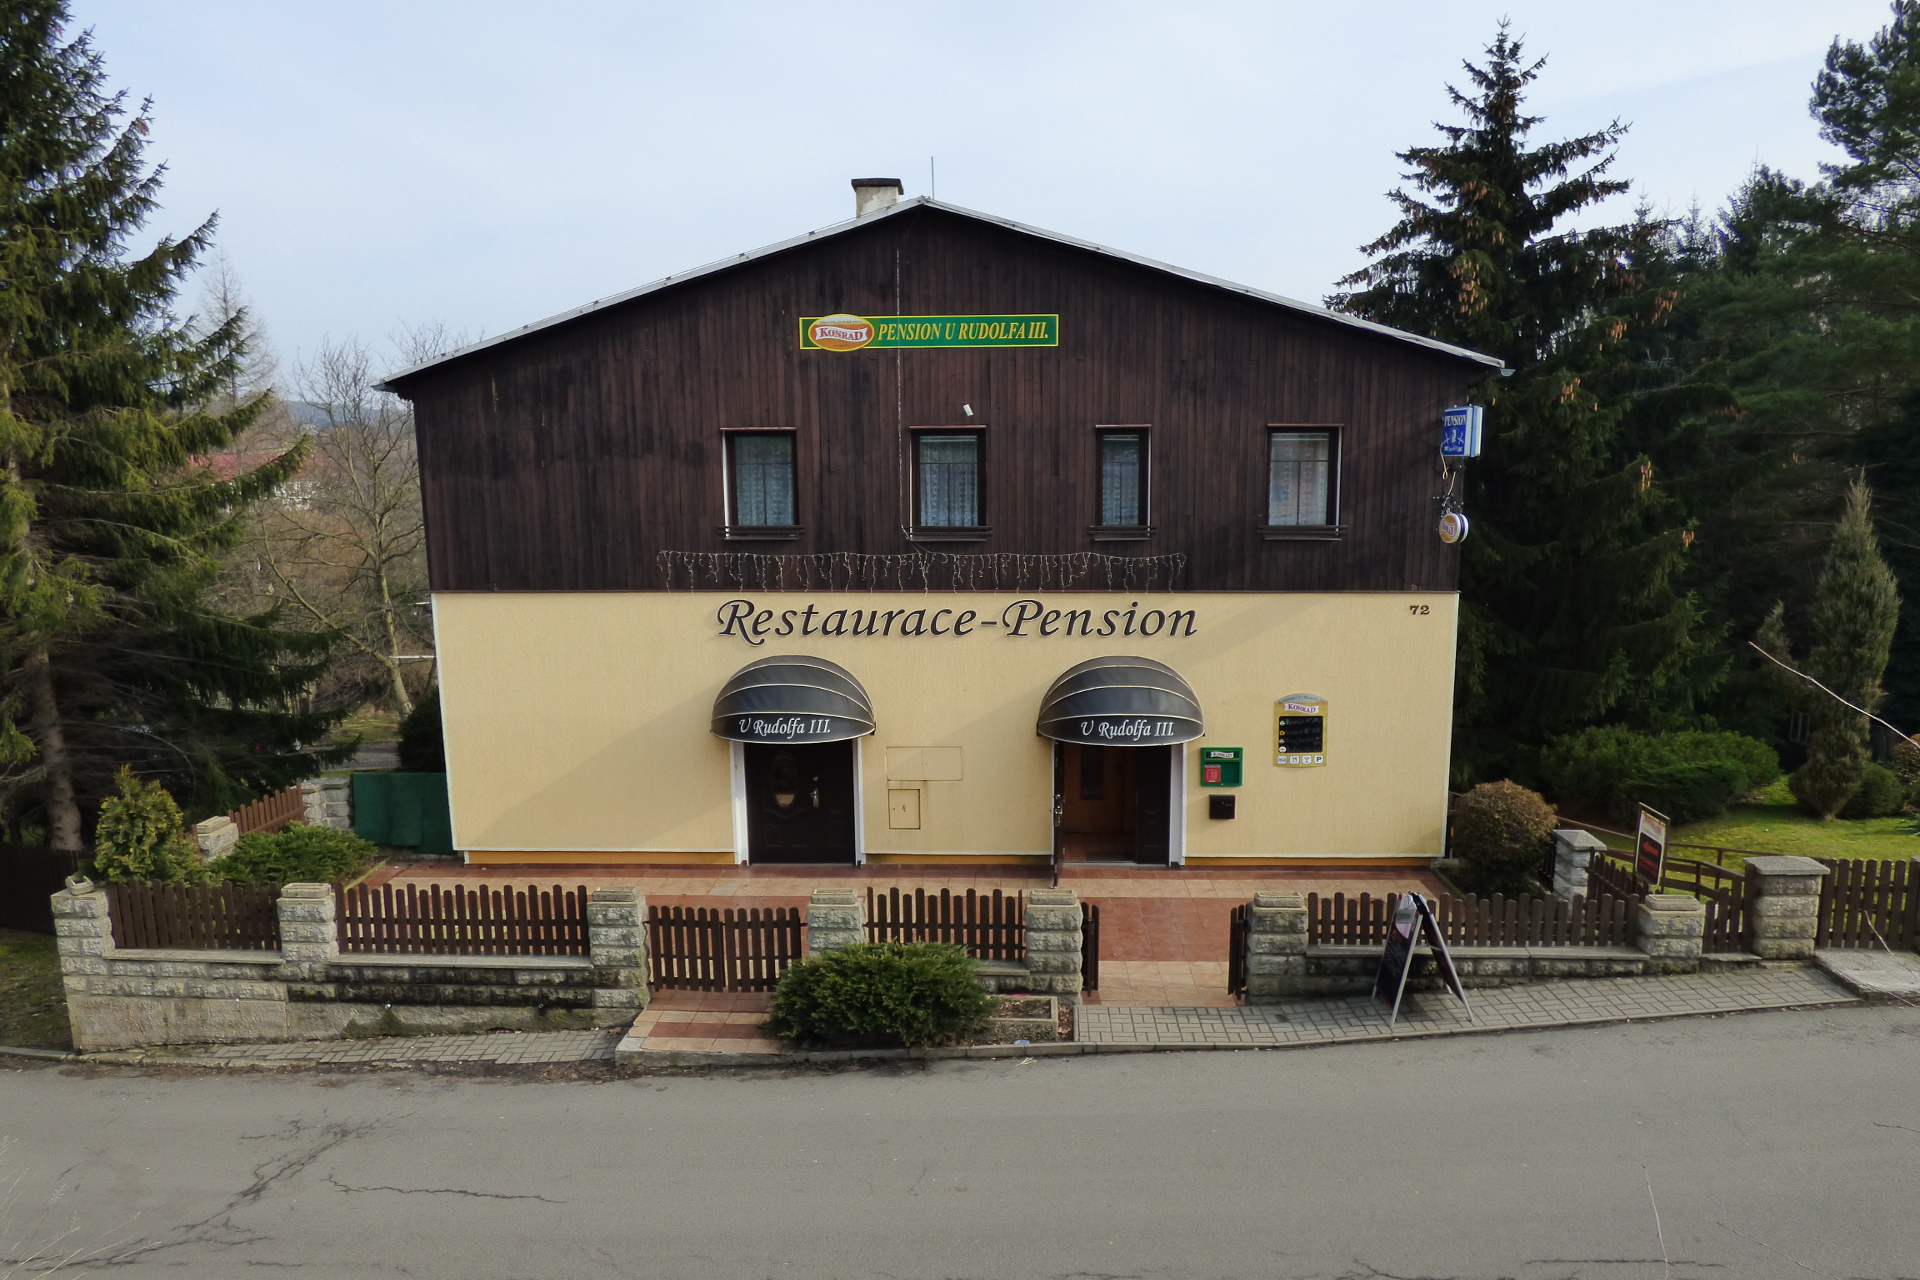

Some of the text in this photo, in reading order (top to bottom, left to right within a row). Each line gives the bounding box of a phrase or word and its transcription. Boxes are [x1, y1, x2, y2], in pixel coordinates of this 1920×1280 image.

[819, 327, 864, 341] KONRAD
[877, 321, 1049, 340] PENSION U RUDOLFA III.
[1444, 415, 1466, 426] PENSION
[1409, 603, 1430, 616] 72
[1287, 703, 1316, 714] KONRAD
[738, 717, 831, 739] U Rudolfa III.
[1080, 719, 1174, 741] U Rudolfa III.
